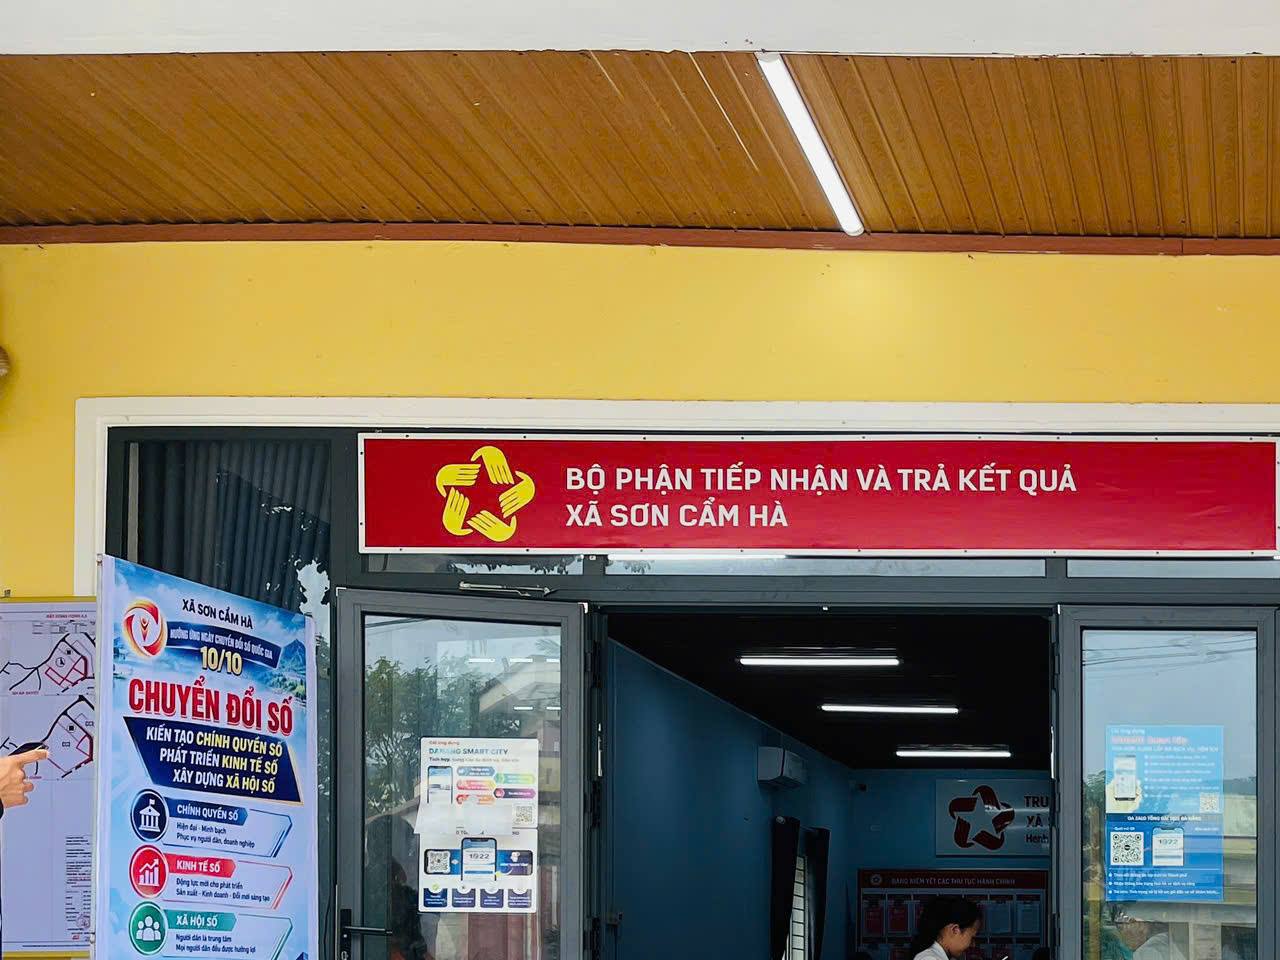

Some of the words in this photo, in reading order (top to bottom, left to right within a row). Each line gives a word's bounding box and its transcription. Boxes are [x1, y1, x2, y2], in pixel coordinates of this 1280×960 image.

[567, 464, 606, 495] BỘ
[616, 464, 692, 495] PHẬN
[700, 461, 761, 490] TIẾP
[771, 464, 848, 495] NHẬN
[856, 465, 892, 491] VÀ
[897, 464, 951, 491] TRẢ
[959, 462, 1012, 491] KẾT
[1019, 464, 1077, 496] QUẢ
[566, 501, 603, 526] XÃ
[610, 502, 669, 526] SƠN
[680, 497, 739, 526] CẨM
[749, 501, 788, 526] HÀ
[182, 599, 195, 613] XÃ
[198, 604, 216, 619] SƠN
[219, 607, 239, 625] CẨM
[241, 615, 253, 629] HÀ
[201, 630, 214, 643] NGÀY
[244, 641, 250, 651] SỐ
[265, 649, 273, 659] GIA
[200, 646, 243, 676] 10/10
[129, 676, 220, 721] CHUYỂN
[226, 686, 262, 730] ĐỔI
[268, 696, 293, 735] SỐ
[146, 724, 171, 742] KIẾN
[174, 730, 194, 746] TẠO
[196, 730, 230, 748] CHÍNH
[232, 736, 266, 754] QUYỀN
[269, 741, 282, 757] SỐ
[160, 746, 187, 762] PHÁT
[190, 749, 220, 767] TRIỂN
[222, 755, 247, 771] KINH
[250, 757, 262, 773] TẾ
[265, 758, 278, 775] SỐ
[173, 767, 192, 783] XÂY
[195, 773, 224, 788] DỰNG
[226, 774, 239, 789] XÃ
[242, 776, 259, 793] HỘI
[262, 778, 275, 793] SỐ
[177, 803, 201, 816] CHÍNH
[202, 807, 226, 819] QUYỀN
[228, 809, 238, 821] SỐ
[1024, 796, 1049, 808] TRU
[177, 860, 196, 871] KINH
[199, 858, 208, 872] TẾ
[209, 860, 220, 873] SỐ
[176, 914, 188, 926] XÃ
[190, 915, 204, 928] HỘI
[207, 915, 218, 927] SỐ
